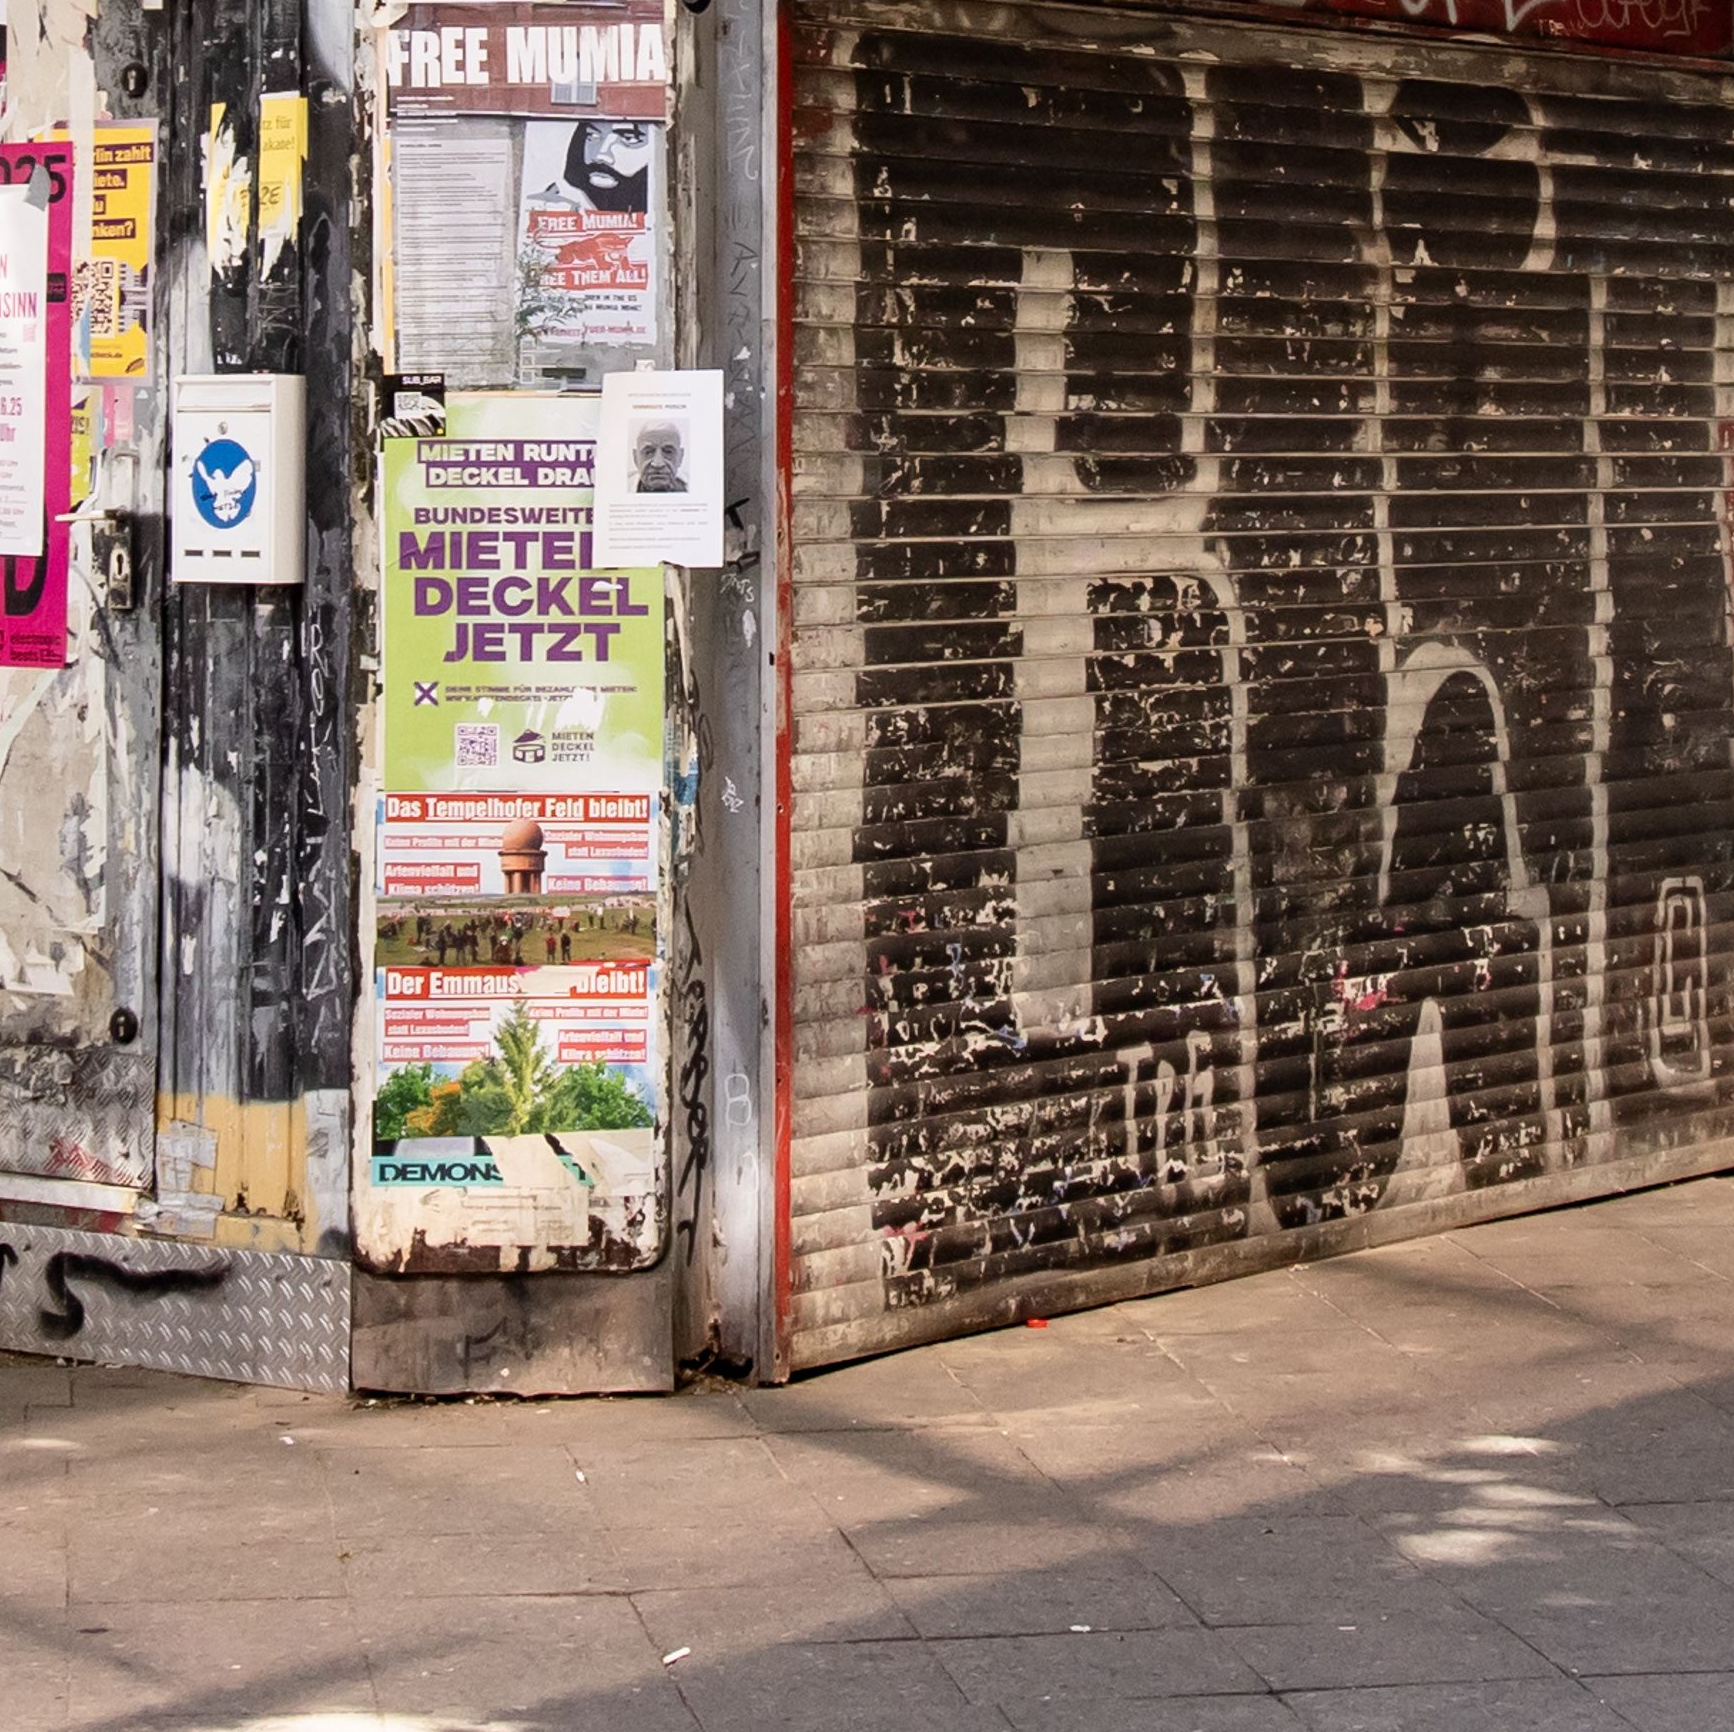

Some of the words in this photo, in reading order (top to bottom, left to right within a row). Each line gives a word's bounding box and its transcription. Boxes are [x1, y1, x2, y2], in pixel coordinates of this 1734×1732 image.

[386, 26, 490, 88] FREE
[506, 23, 666, 85] MUMIA
[115, 144, 153, 162] zahlt
[93, 171, 126, 188] iete.
[537, 215, 577, 231] FREE
[582, 212, 638, 230] MUMIA!
[573, 269, 612, 286] THEM
[616, 268, 647, 284] ALL!
[420, 444, 516, 463] MIETEN
[522, 443, 596, 463] RUNT
[428, 467, 534, 487] DECKEL
[414, 576, 649, 617] DECKEL
[443, 622, 622, 663] JETZT
[387, 798, 422, 818] Das
[425, 797, 542, 820] Tempelhofer
[545, 797, 585, 818] Feld
[588, 797, 649, 819] bleibt!
[388, 972, 424, 995] Der
